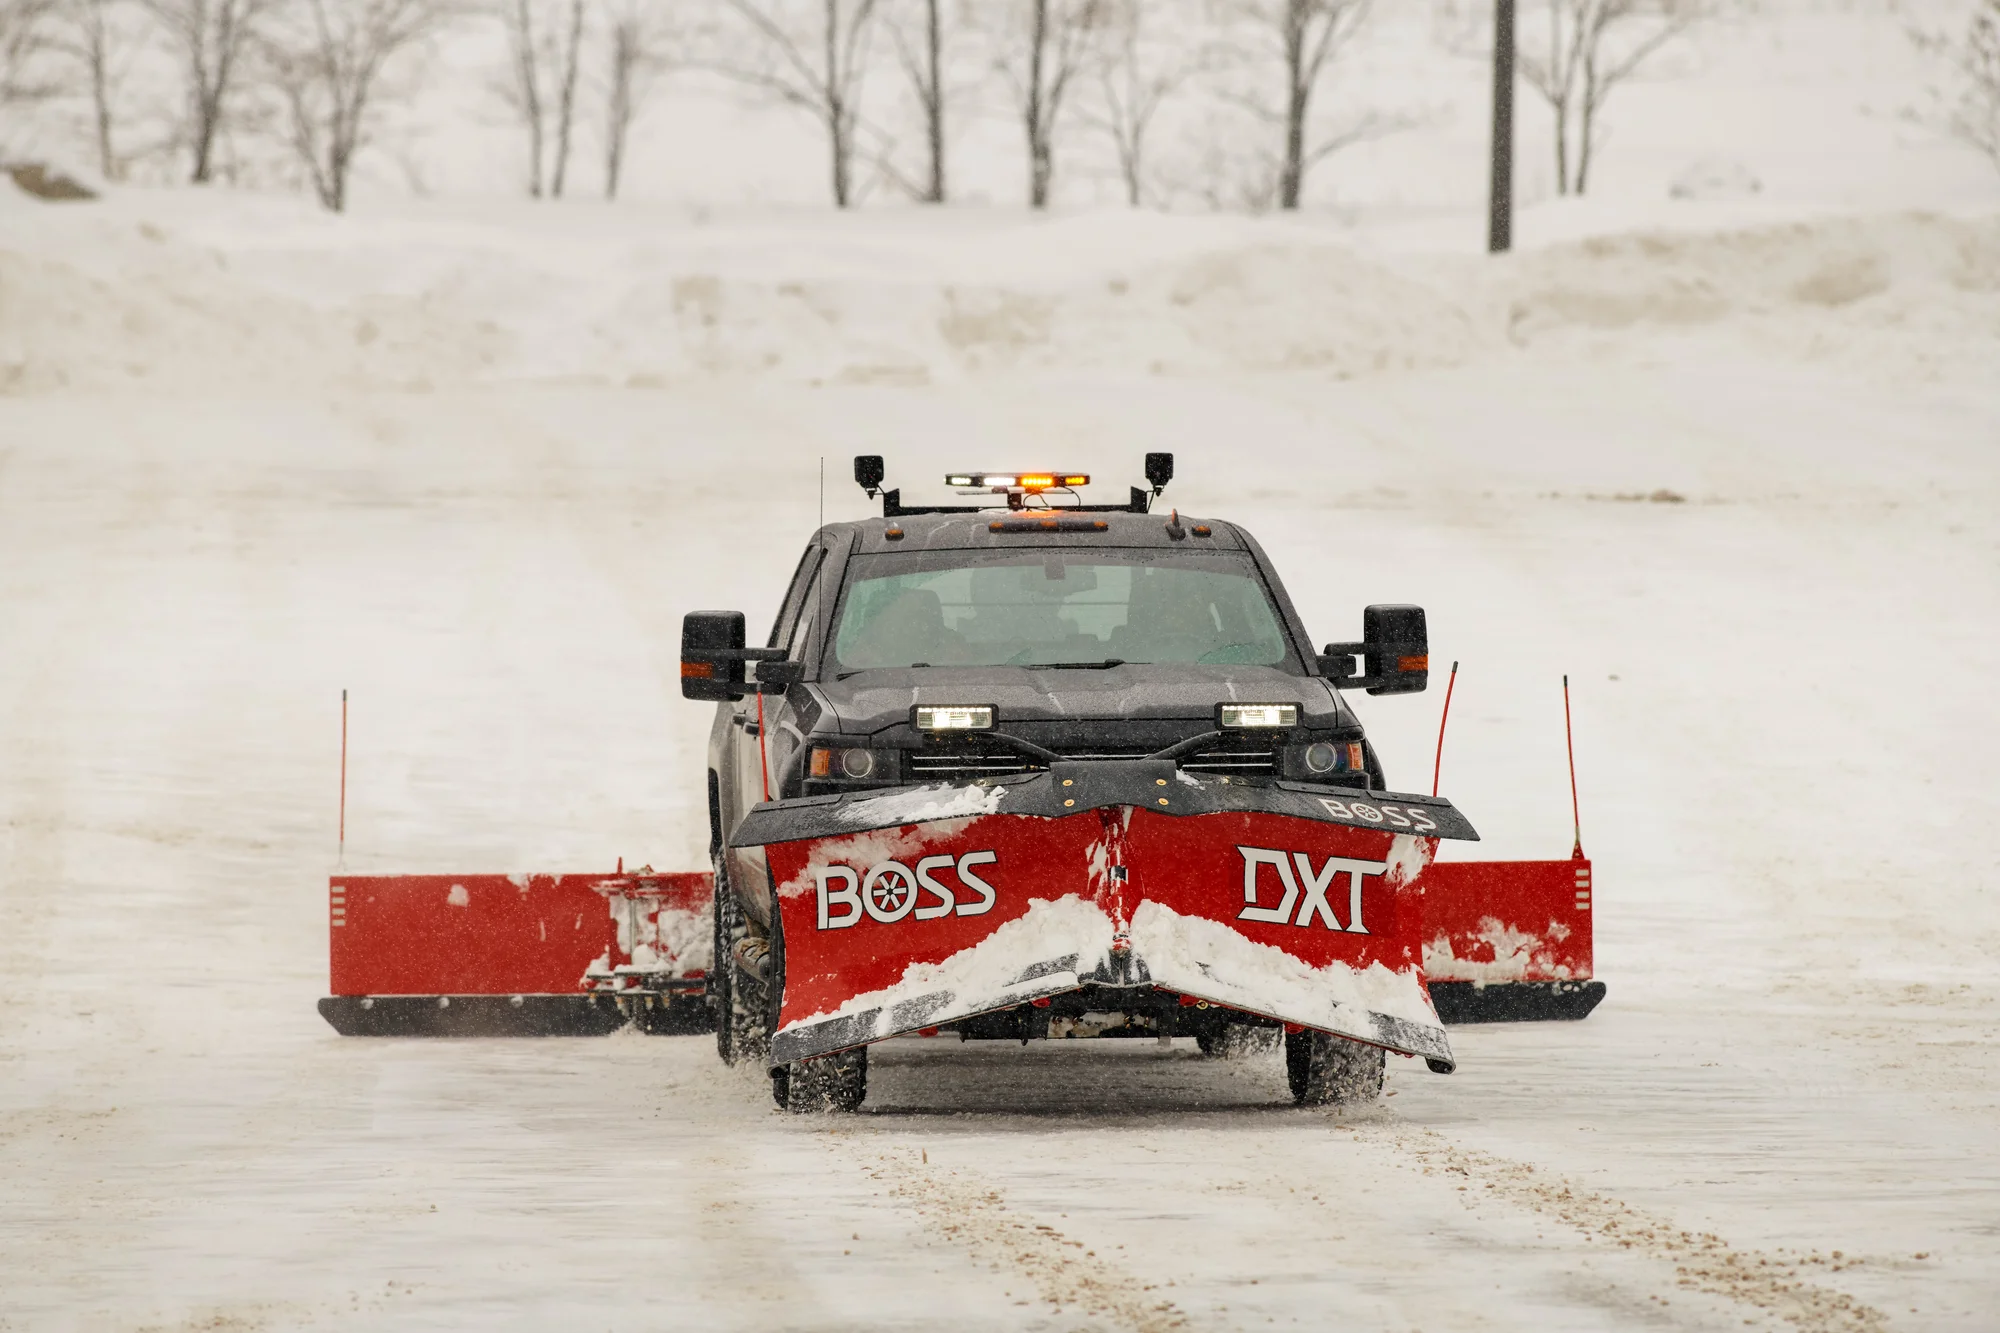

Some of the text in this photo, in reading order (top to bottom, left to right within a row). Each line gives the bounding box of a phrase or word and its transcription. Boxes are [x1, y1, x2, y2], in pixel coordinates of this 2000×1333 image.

[1319, 798, 1437, 833] BOSS
[816, 850, 997, 930] BOSS
[1235, 844, 1389, 934] DXT
